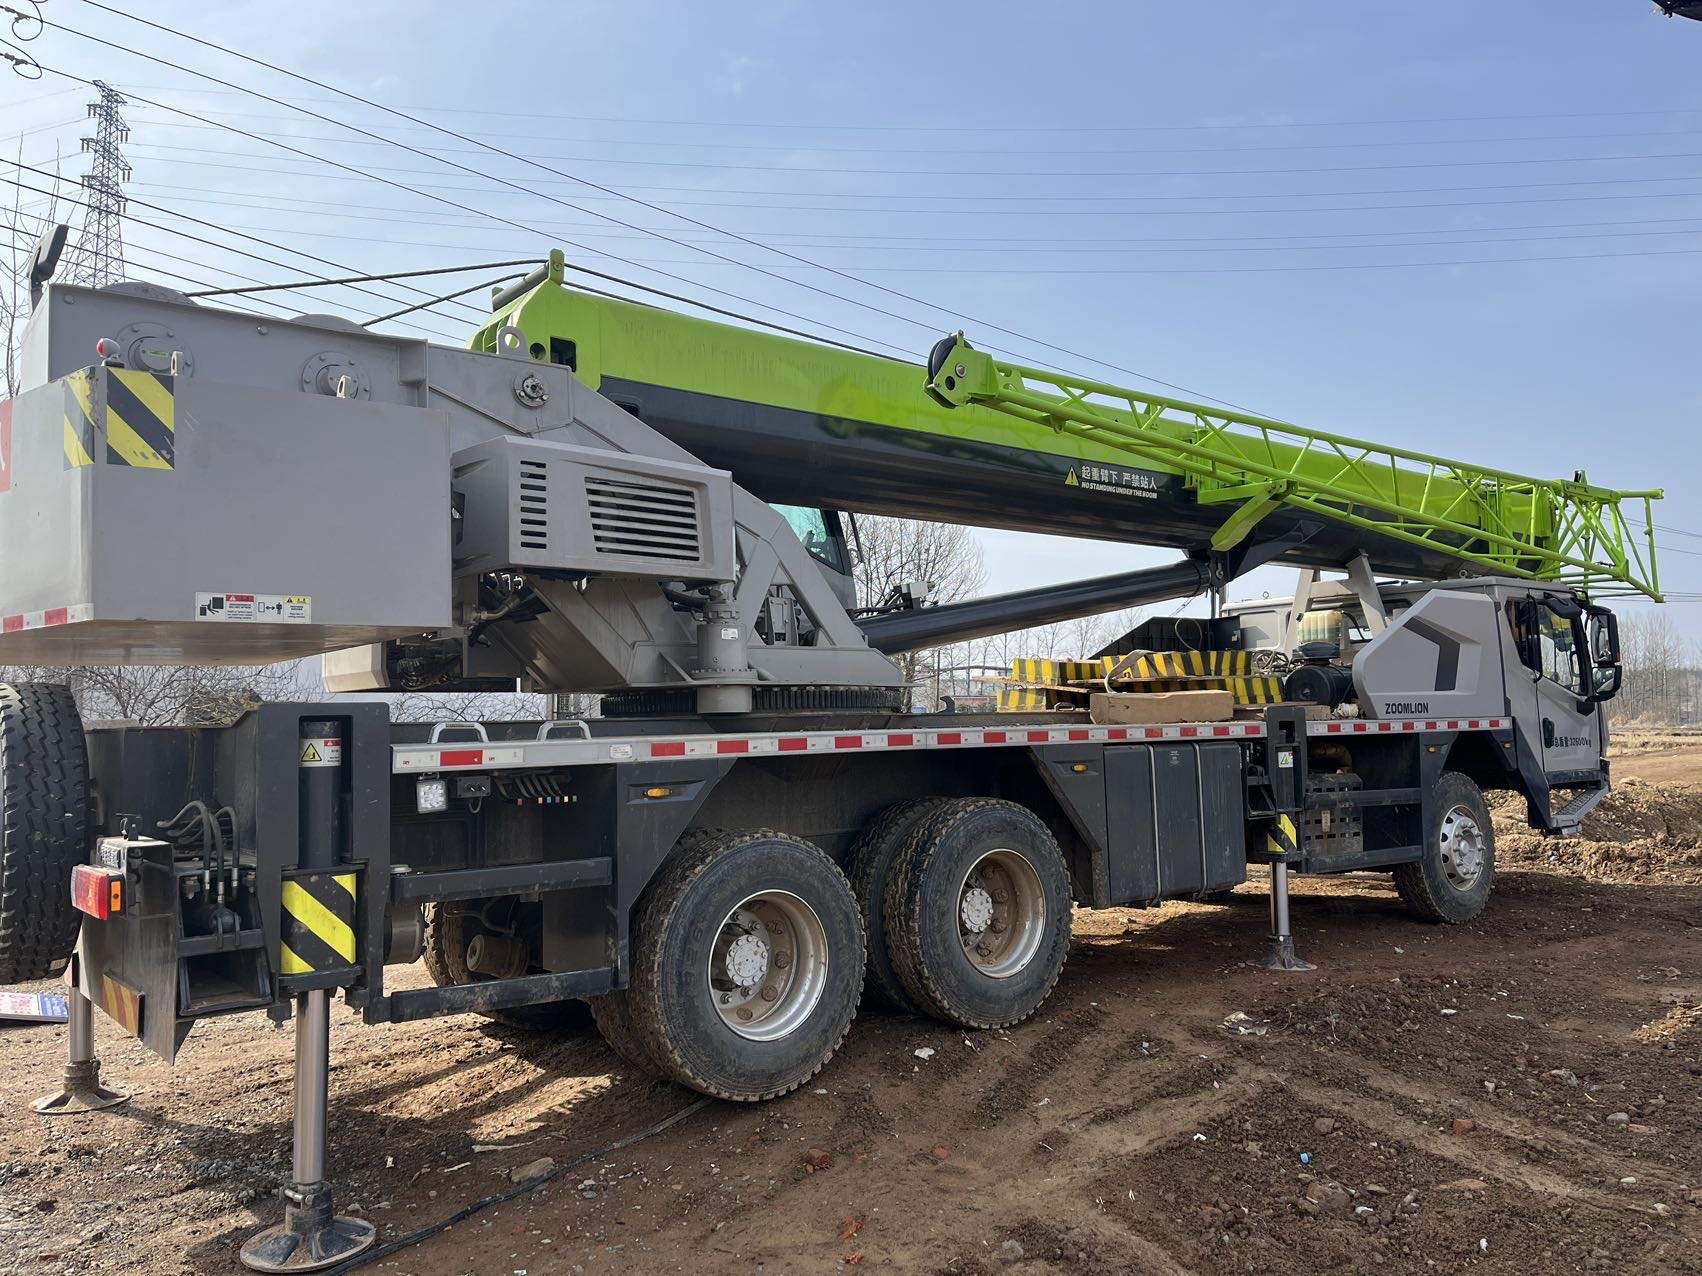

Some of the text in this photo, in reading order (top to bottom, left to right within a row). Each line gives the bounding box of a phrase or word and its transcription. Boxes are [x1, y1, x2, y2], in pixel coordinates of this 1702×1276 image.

[1081, 465, 1157, 490] 起重臂下 严禁站人
[1081, 481, 1090, 489] NO
[1090, 483, 1115, 493] STANDING
[1115, 486, 1133, 495] UNDER
[1132, 489, 1142, 497] THE
[1384, 702, 1429, 714] ZOOMLION
